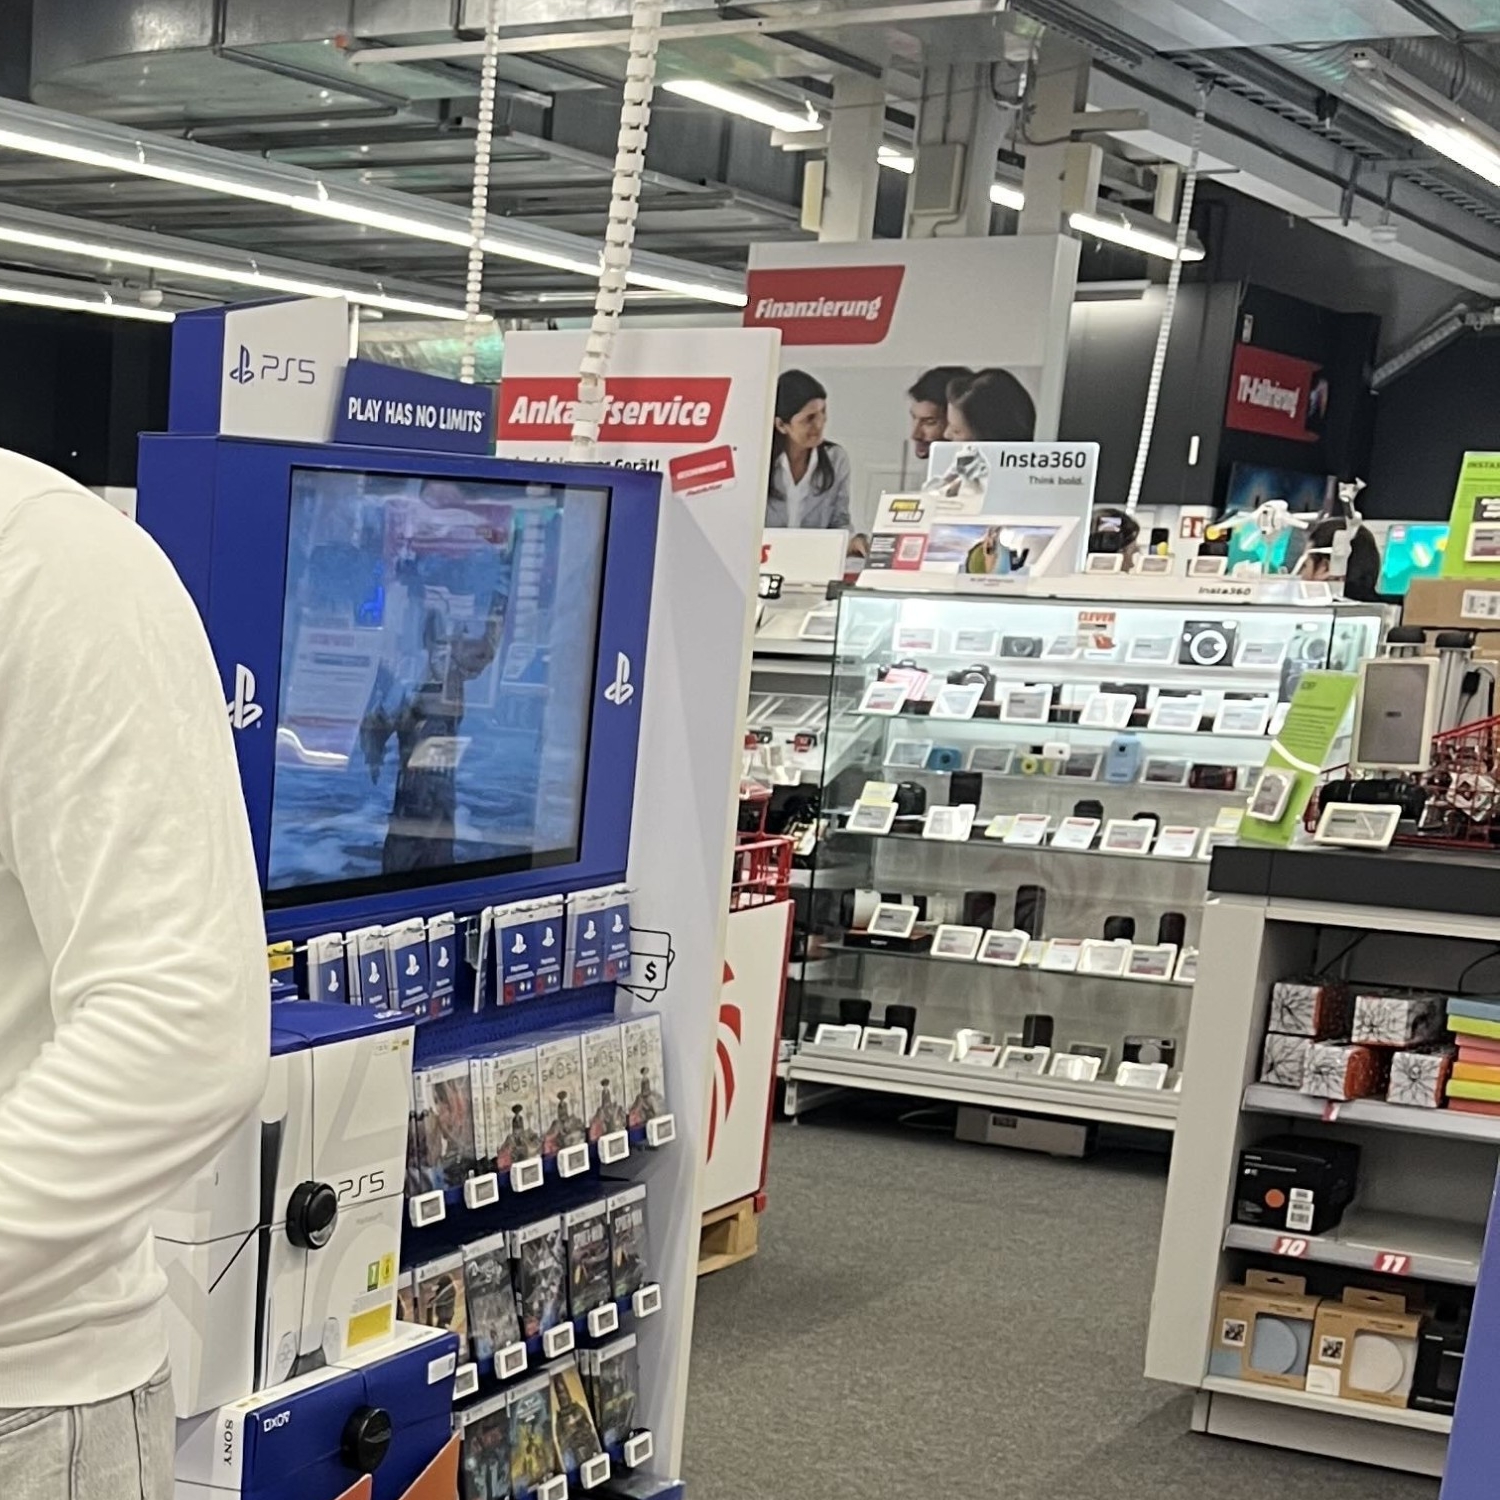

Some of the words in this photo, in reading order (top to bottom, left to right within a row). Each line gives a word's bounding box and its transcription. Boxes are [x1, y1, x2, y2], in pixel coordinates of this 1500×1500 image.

[755, 296, 883, 322] Finanzierung
[261, 354, 316, 385] PS5
[348, 396, 383, 424] PLAY
[385, 400, 413, 427] HAS
[416, 404, 438, 430] NO
[508, 395, 712, 427] Ankafservice
[1000, 450, 1087, 469] Insta360
[1029, 475, 1060, 486] Think
[1063, 475, 1084, 487] bold.
[1198, 586, 1252, 597] Insta360
[1077, 611, 1117, 623] CLEVER
[338, 1170, 385, 1200] PS5
[1278, 1238, 1308, 1257] 10
[1380, 1254, 1408, 1273] 11
[223, 1418, 235, 1467] SONY
